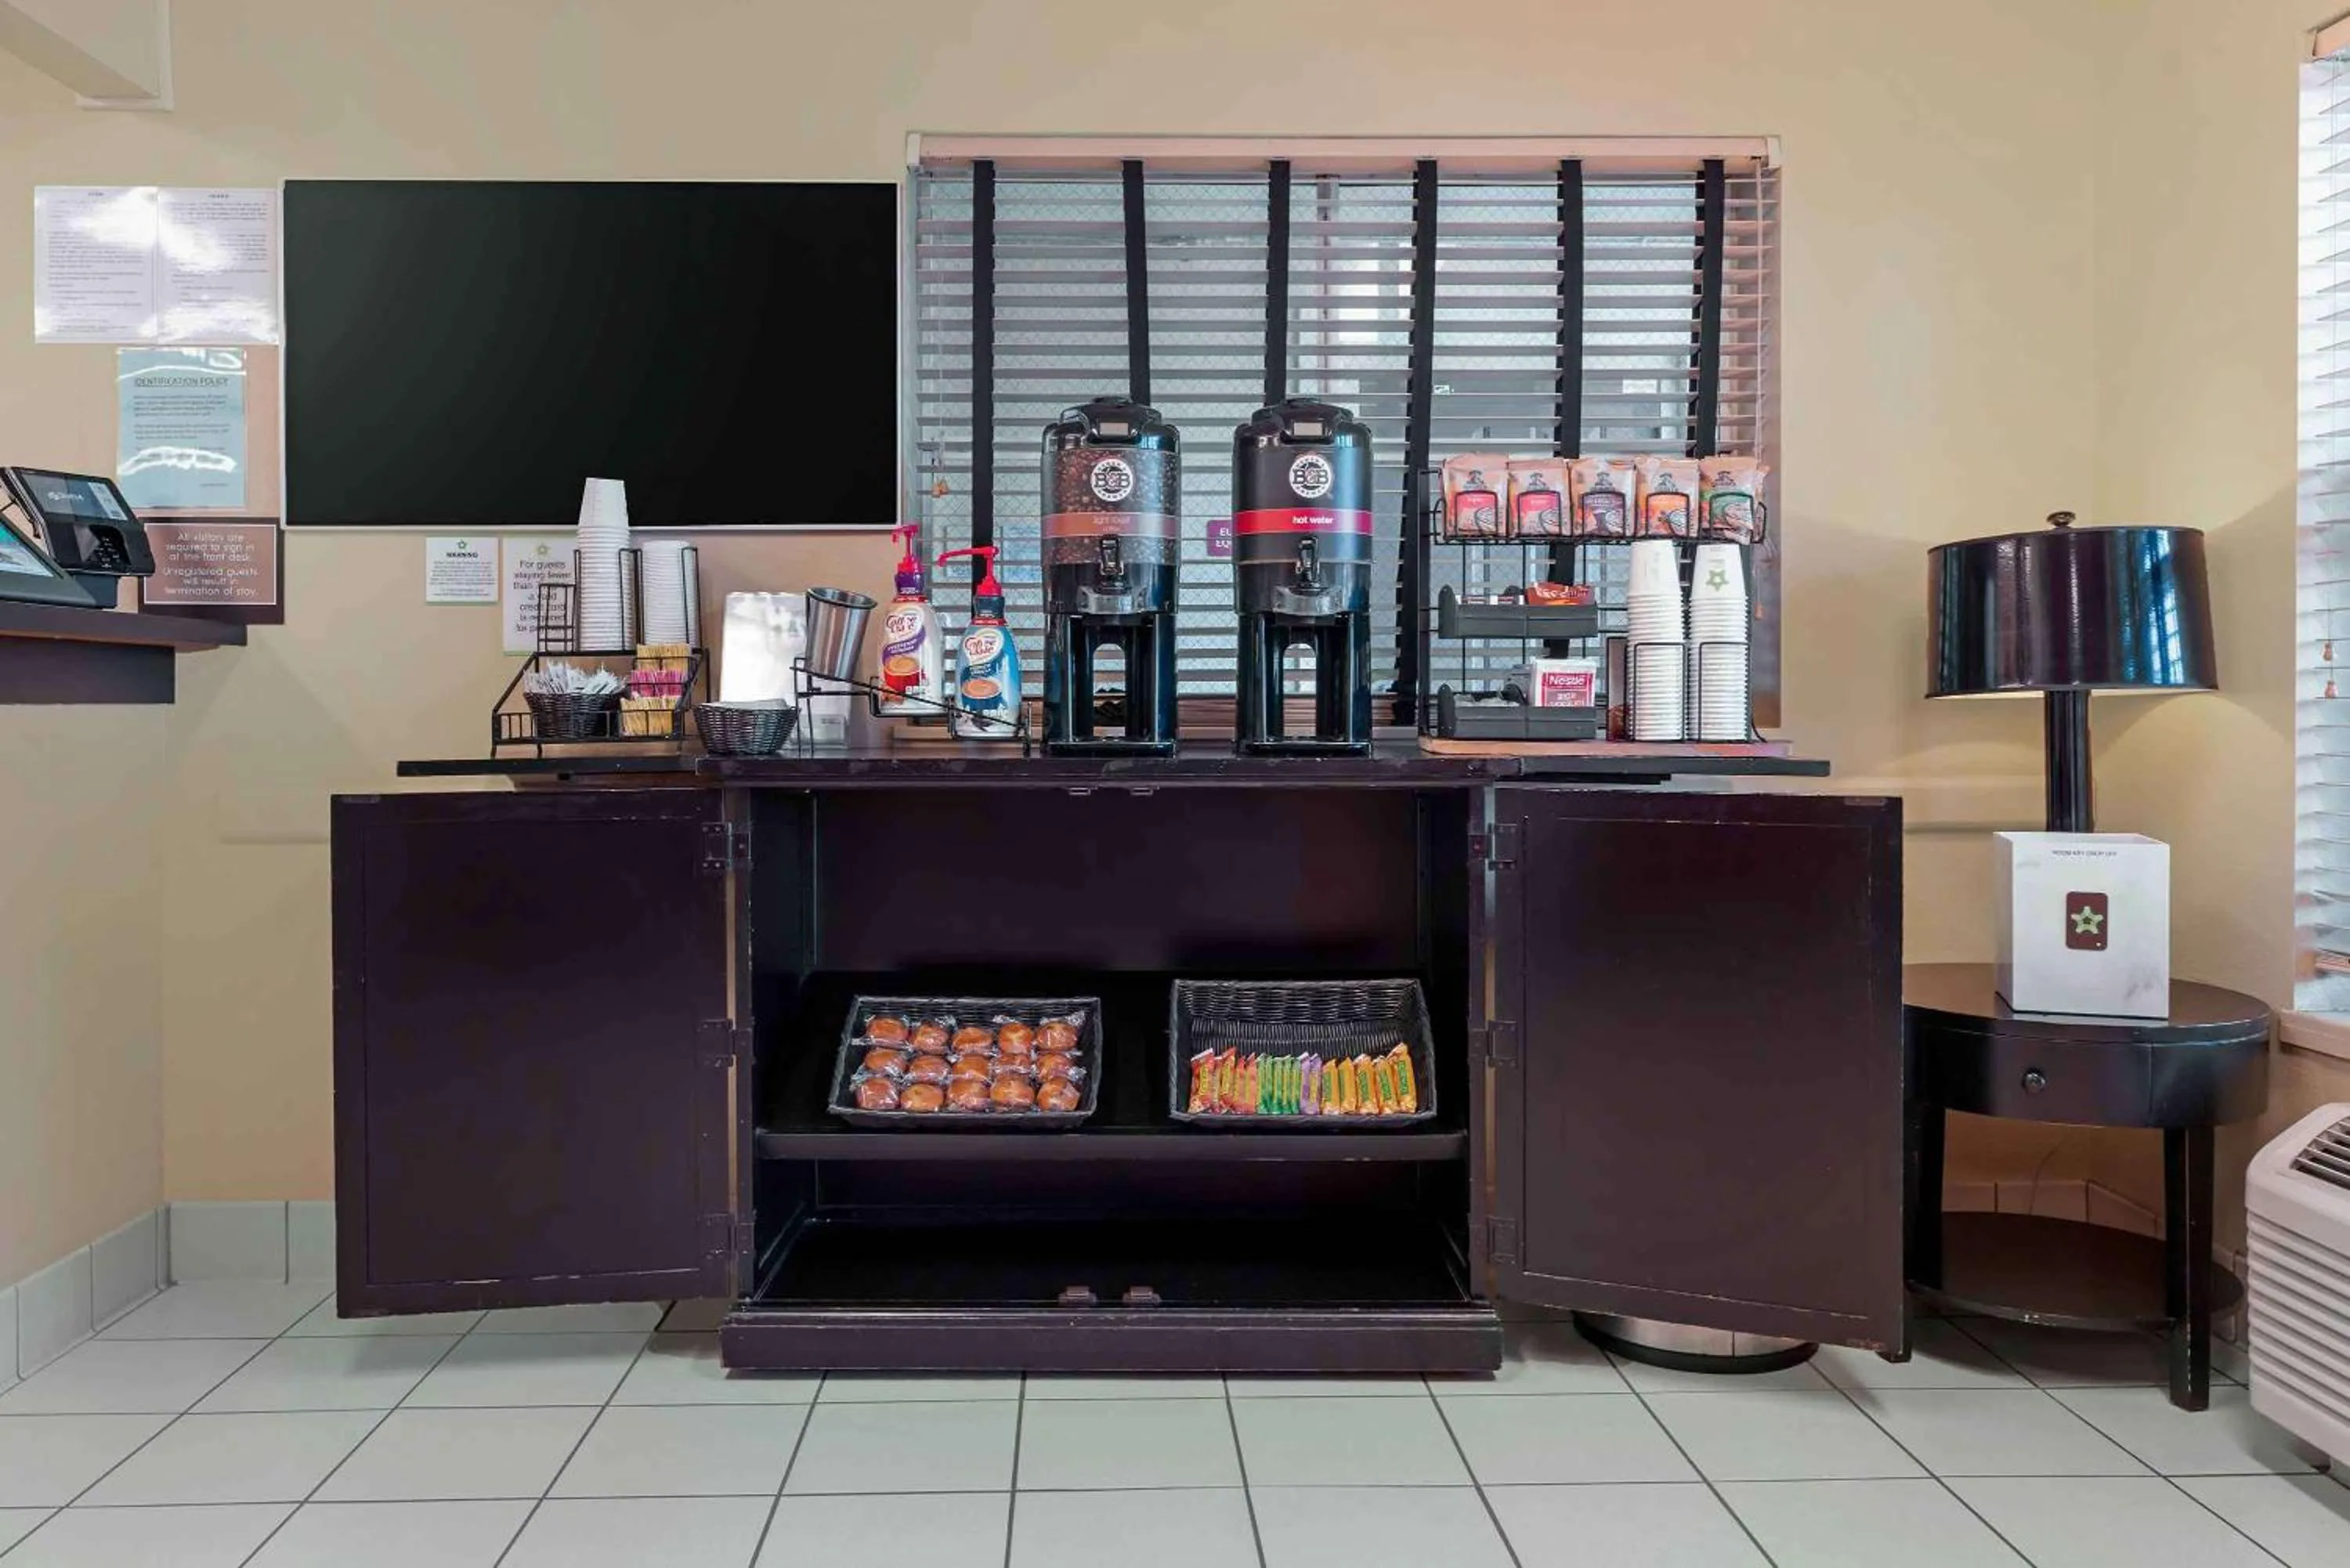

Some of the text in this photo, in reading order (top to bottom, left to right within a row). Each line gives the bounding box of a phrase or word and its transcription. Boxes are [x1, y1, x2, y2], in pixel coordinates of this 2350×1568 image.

[1292, 515, 1307, 524] hot
[194, 533, 223, 541] visitors
[166, 544, 208, 553] required
[212, 544, 220, 552] to
[224, 544, 242, 554] sign
[168, 553, 179, 562] at
[203, 552, 226, 562] front
[163, 566, 258, 578] Unregistered guests
[164, 587, 220, 595] termination
[223, 587, 233, 595] of
